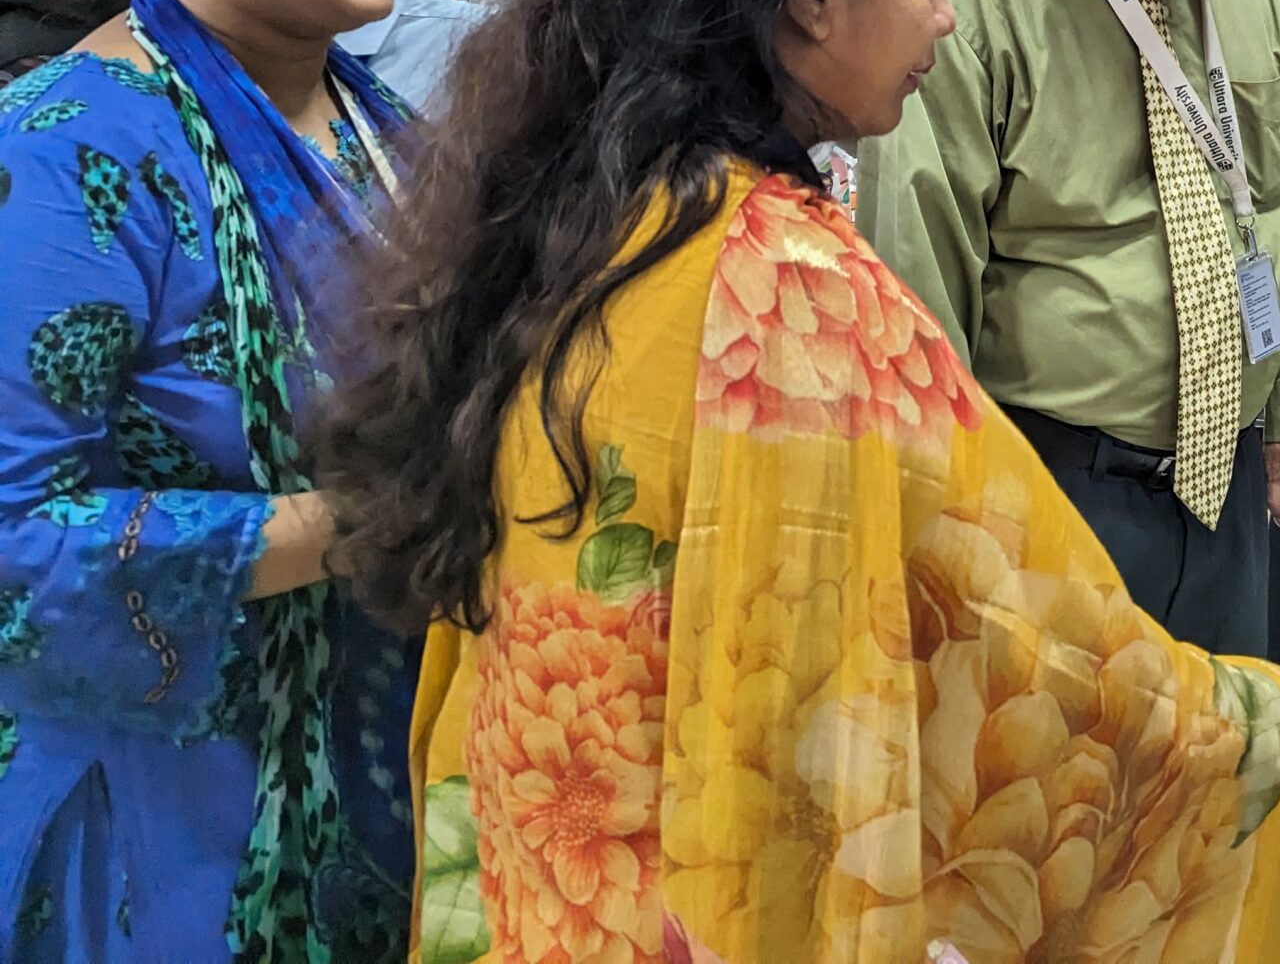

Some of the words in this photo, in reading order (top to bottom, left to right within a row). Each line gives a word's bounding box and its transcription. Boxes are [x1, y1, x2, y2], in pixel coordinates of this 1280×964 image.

[1174, 84, 1208, 135] University
[1213, 79, 1228, 114] Uttara
[1203, 132, 1226, 162] Uttara
